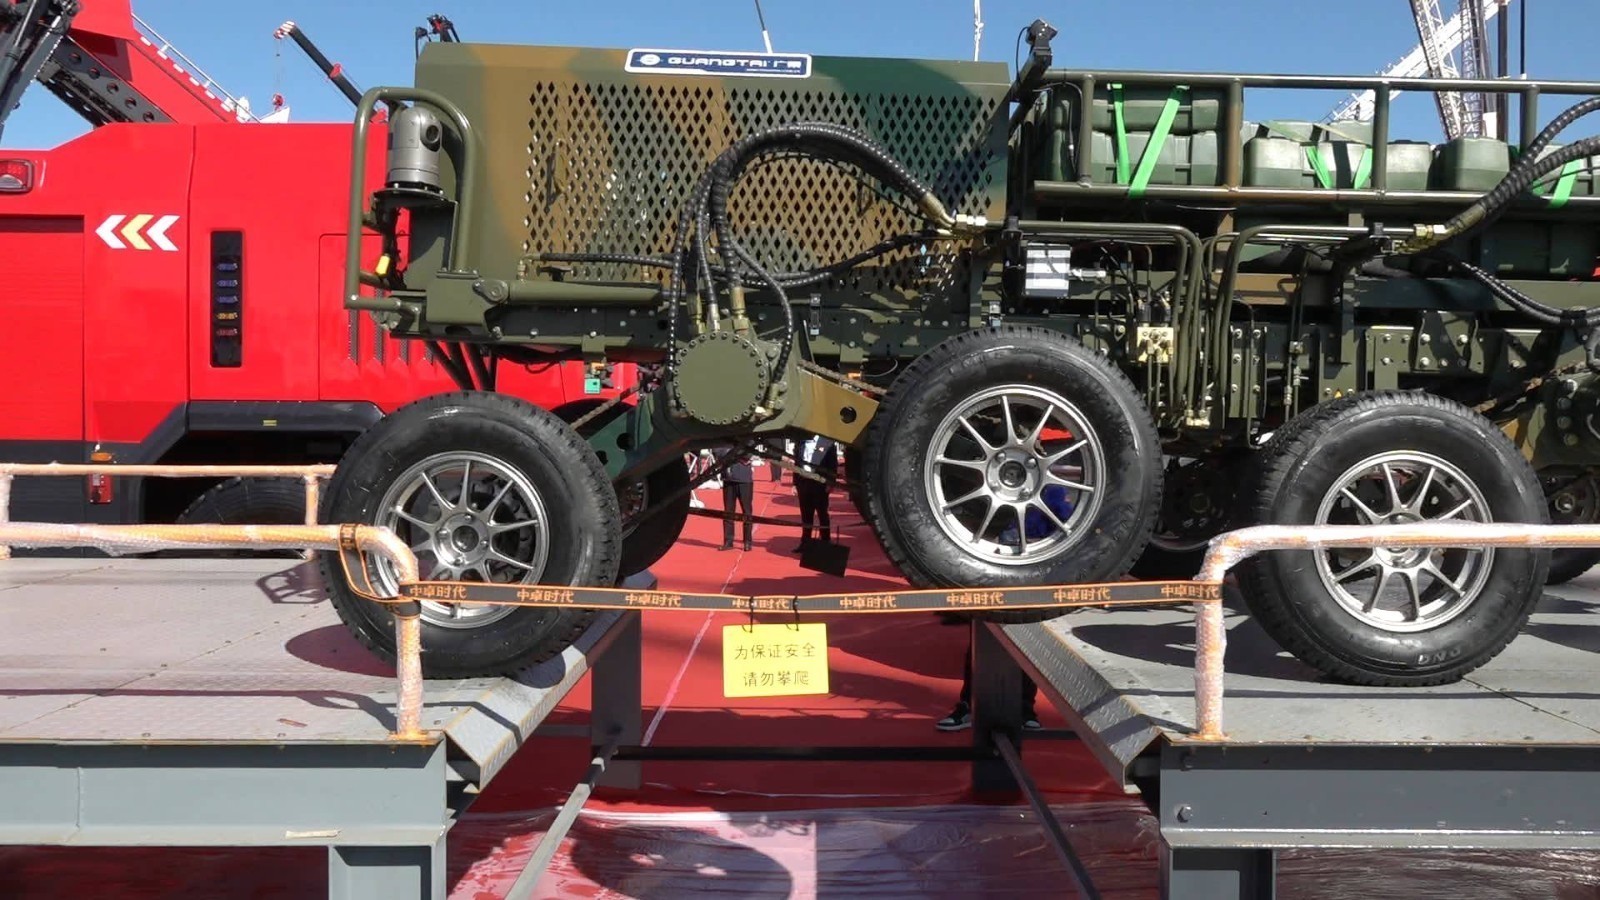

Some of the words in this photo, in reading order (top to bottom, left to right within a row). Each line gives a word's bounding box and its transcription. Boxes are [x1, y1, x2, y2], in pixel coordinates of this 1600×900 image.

[667, 57, 767, 68] GUANGTAI
[516, 587, 575, 604] 中卓时代
[625, 592, 682, 607] 中卓时代
[839, 595, 898, 609] 中卓时代
[946, 591, 1005, 606] 中卓时代
[1053, 586, 1112, 602] 中卓时代
[734, 642, 816, 660] 为保证安全
[743, 670, 810, 687] 请勿攀爬
